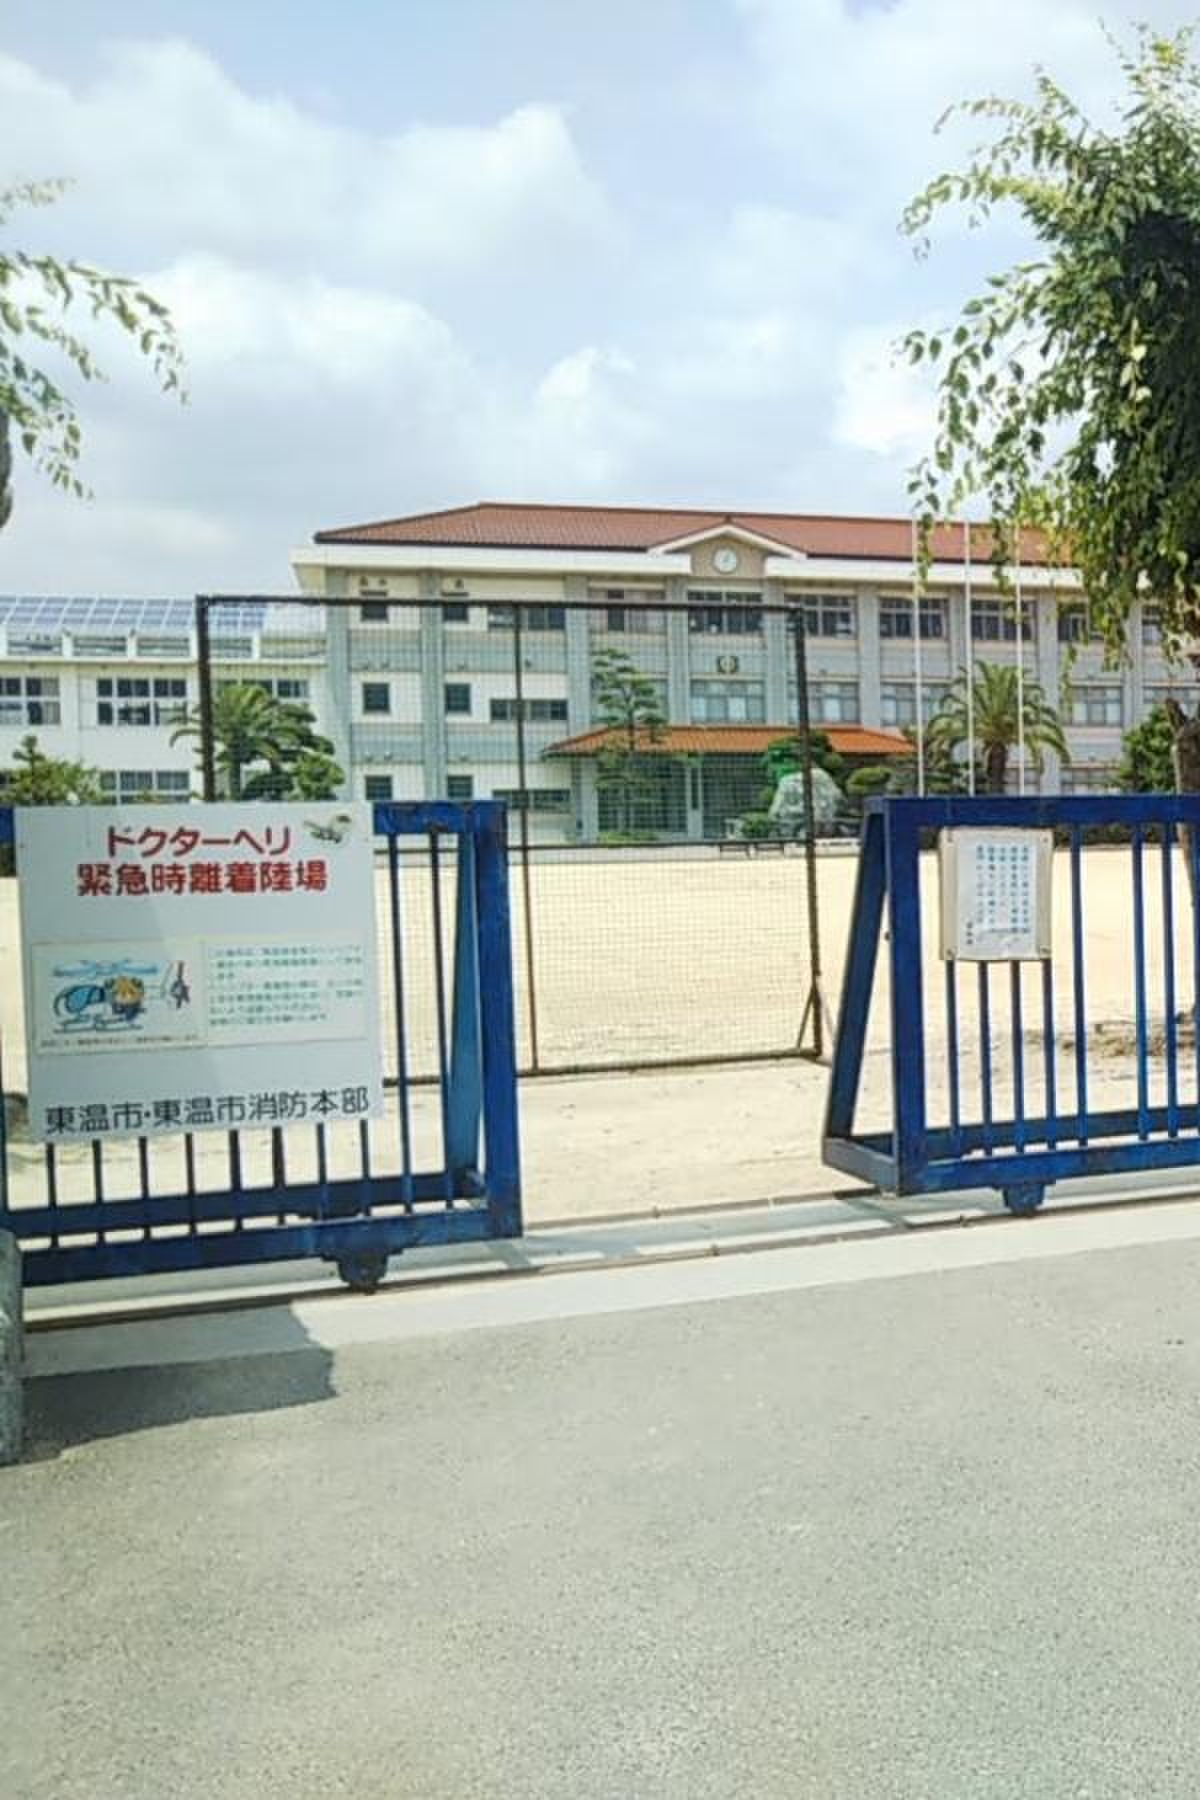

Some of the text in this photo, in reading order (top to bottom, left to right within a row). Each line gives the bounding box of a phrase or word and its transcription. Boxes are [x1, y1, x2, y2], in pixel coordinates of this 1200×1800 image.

[107, 826, 291, 857] ドクターヘリ
[77, 860, 328, 897] 緊急時離着陸場
